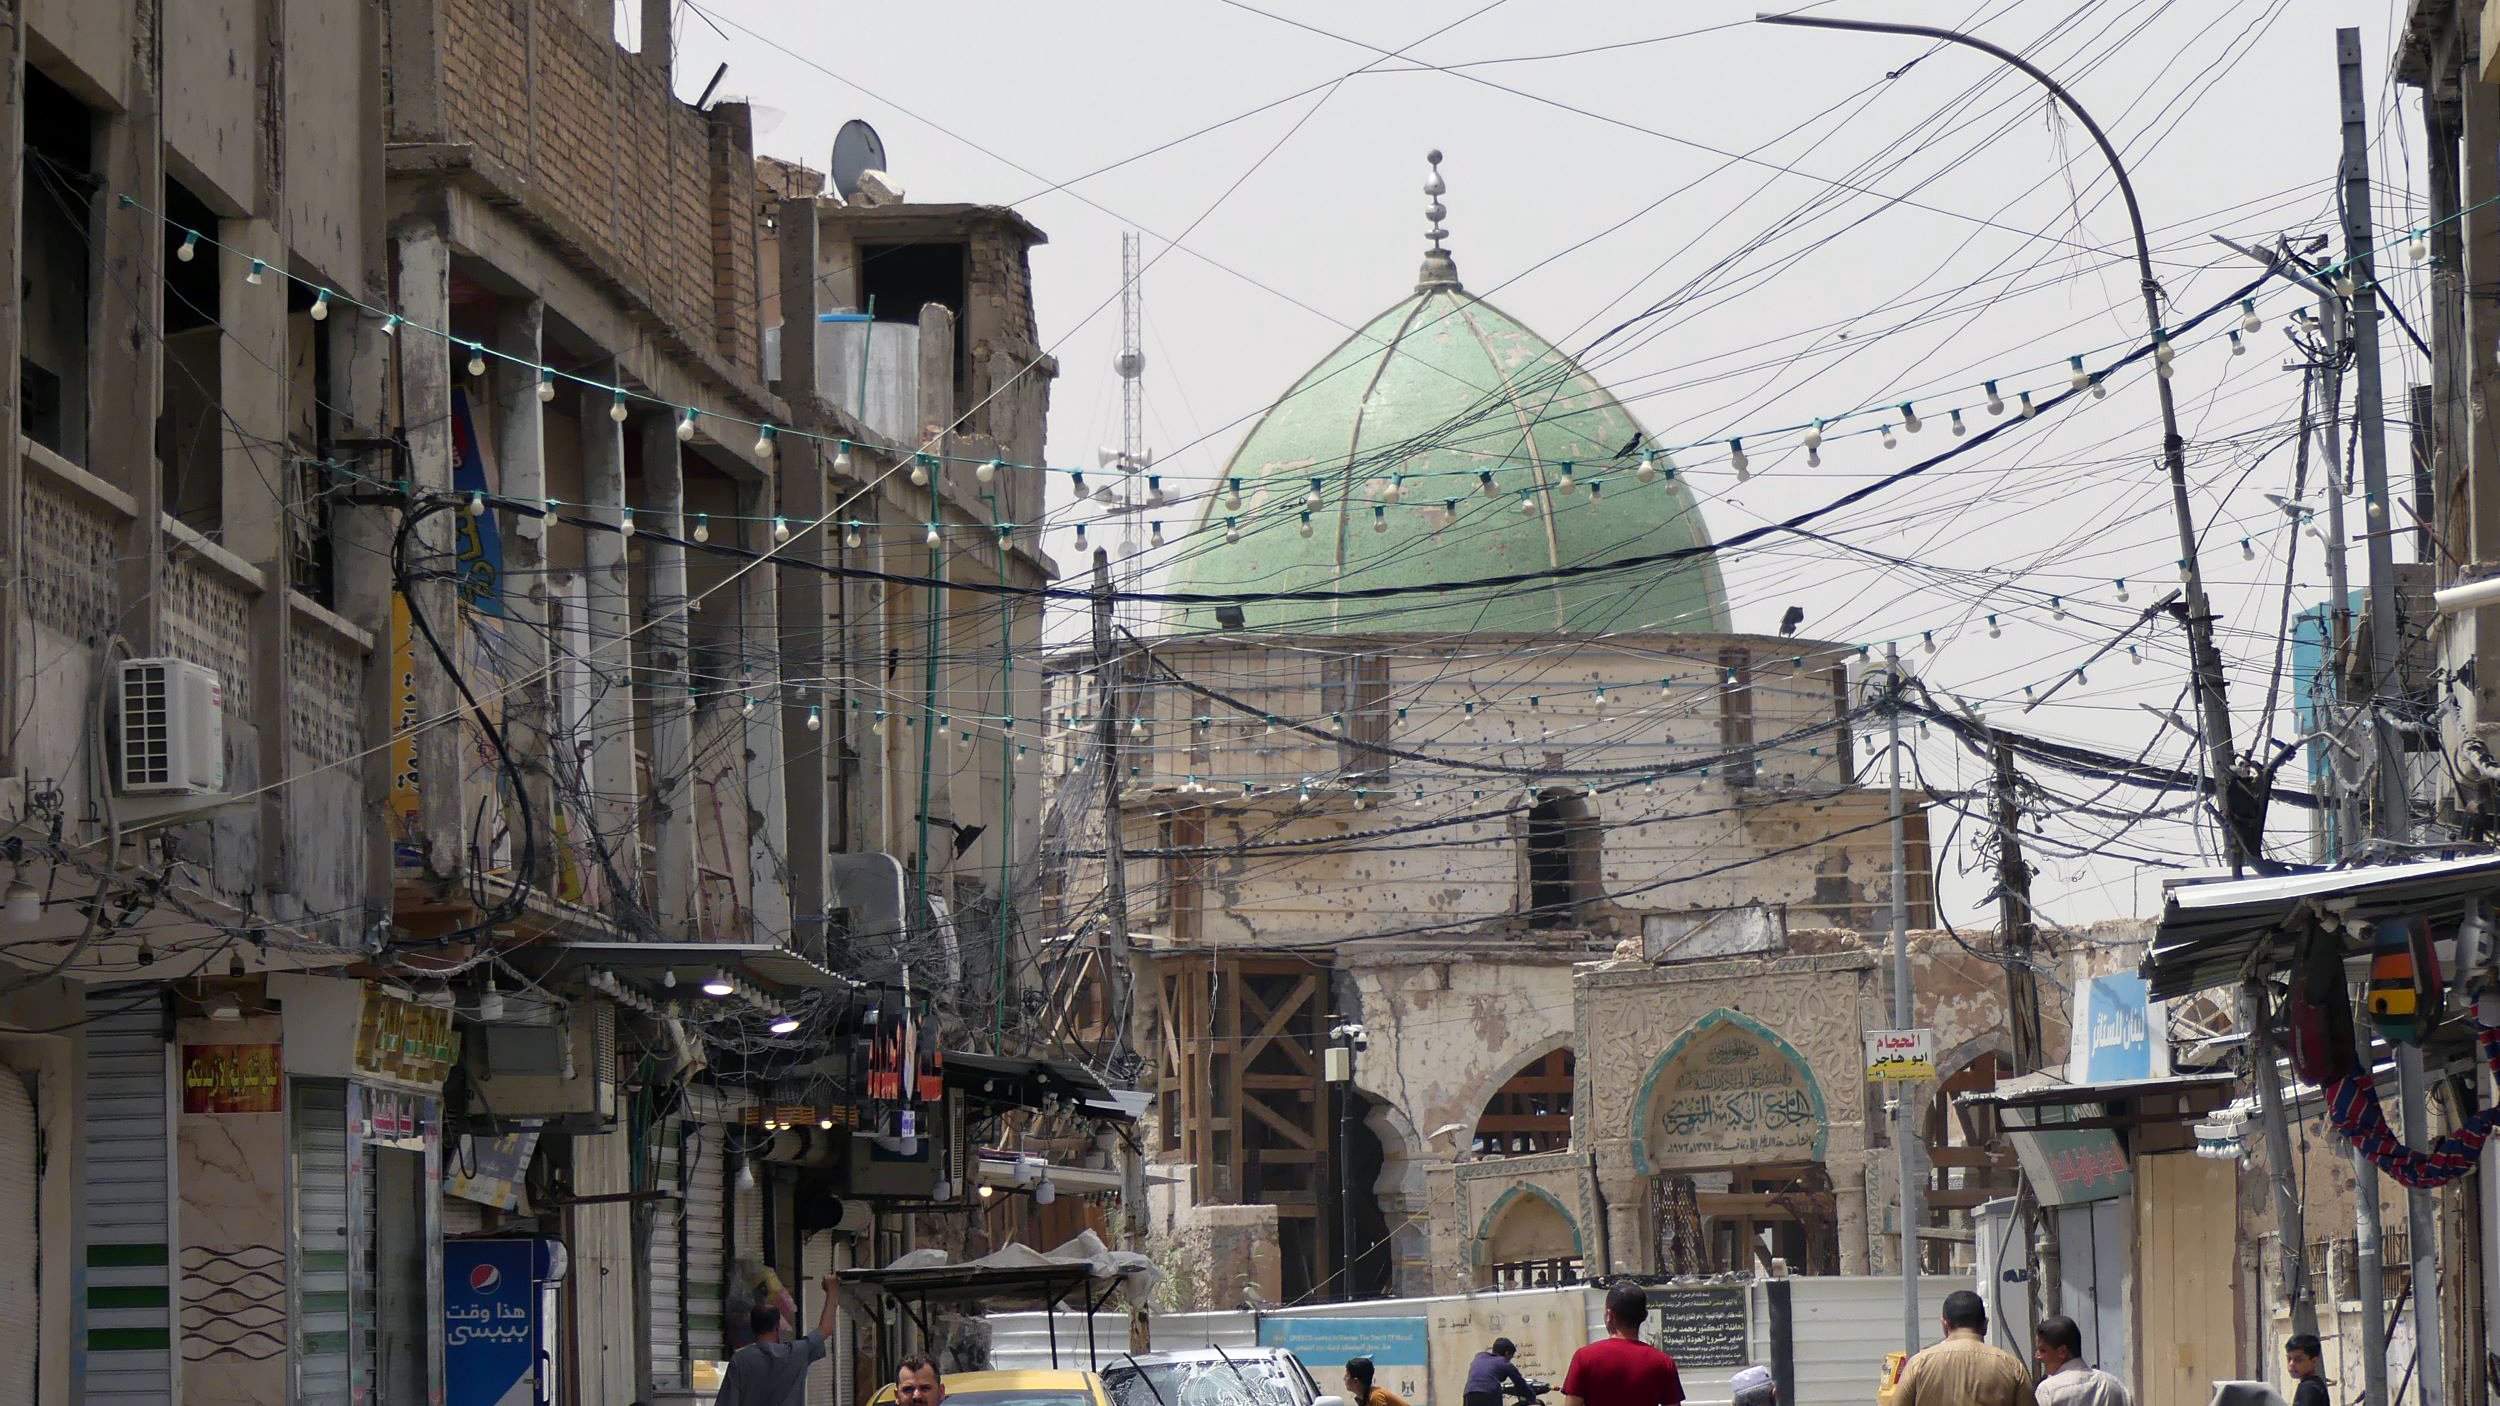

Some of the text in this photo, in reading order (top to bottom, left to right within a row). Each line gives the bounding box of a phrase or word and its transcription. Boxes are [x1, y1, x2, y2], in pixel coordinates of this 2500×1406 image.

[1876, 1033, 1921, 1052] الحجام
[1872, 1052, 1928, 1067] ابو هاجر
[1662, 1088, 1814, 1135] الجامع الكبير النوري
[445, 1301, 526, 1323] هذا وقت
[1662, 1325, 1678, 1333] خالد
[1698, 1323, 1725, 1334] الدكتور
[1706, 1333, 1728, 1344] مشروع
[1728, 1335, 1744, 1344] مدير
